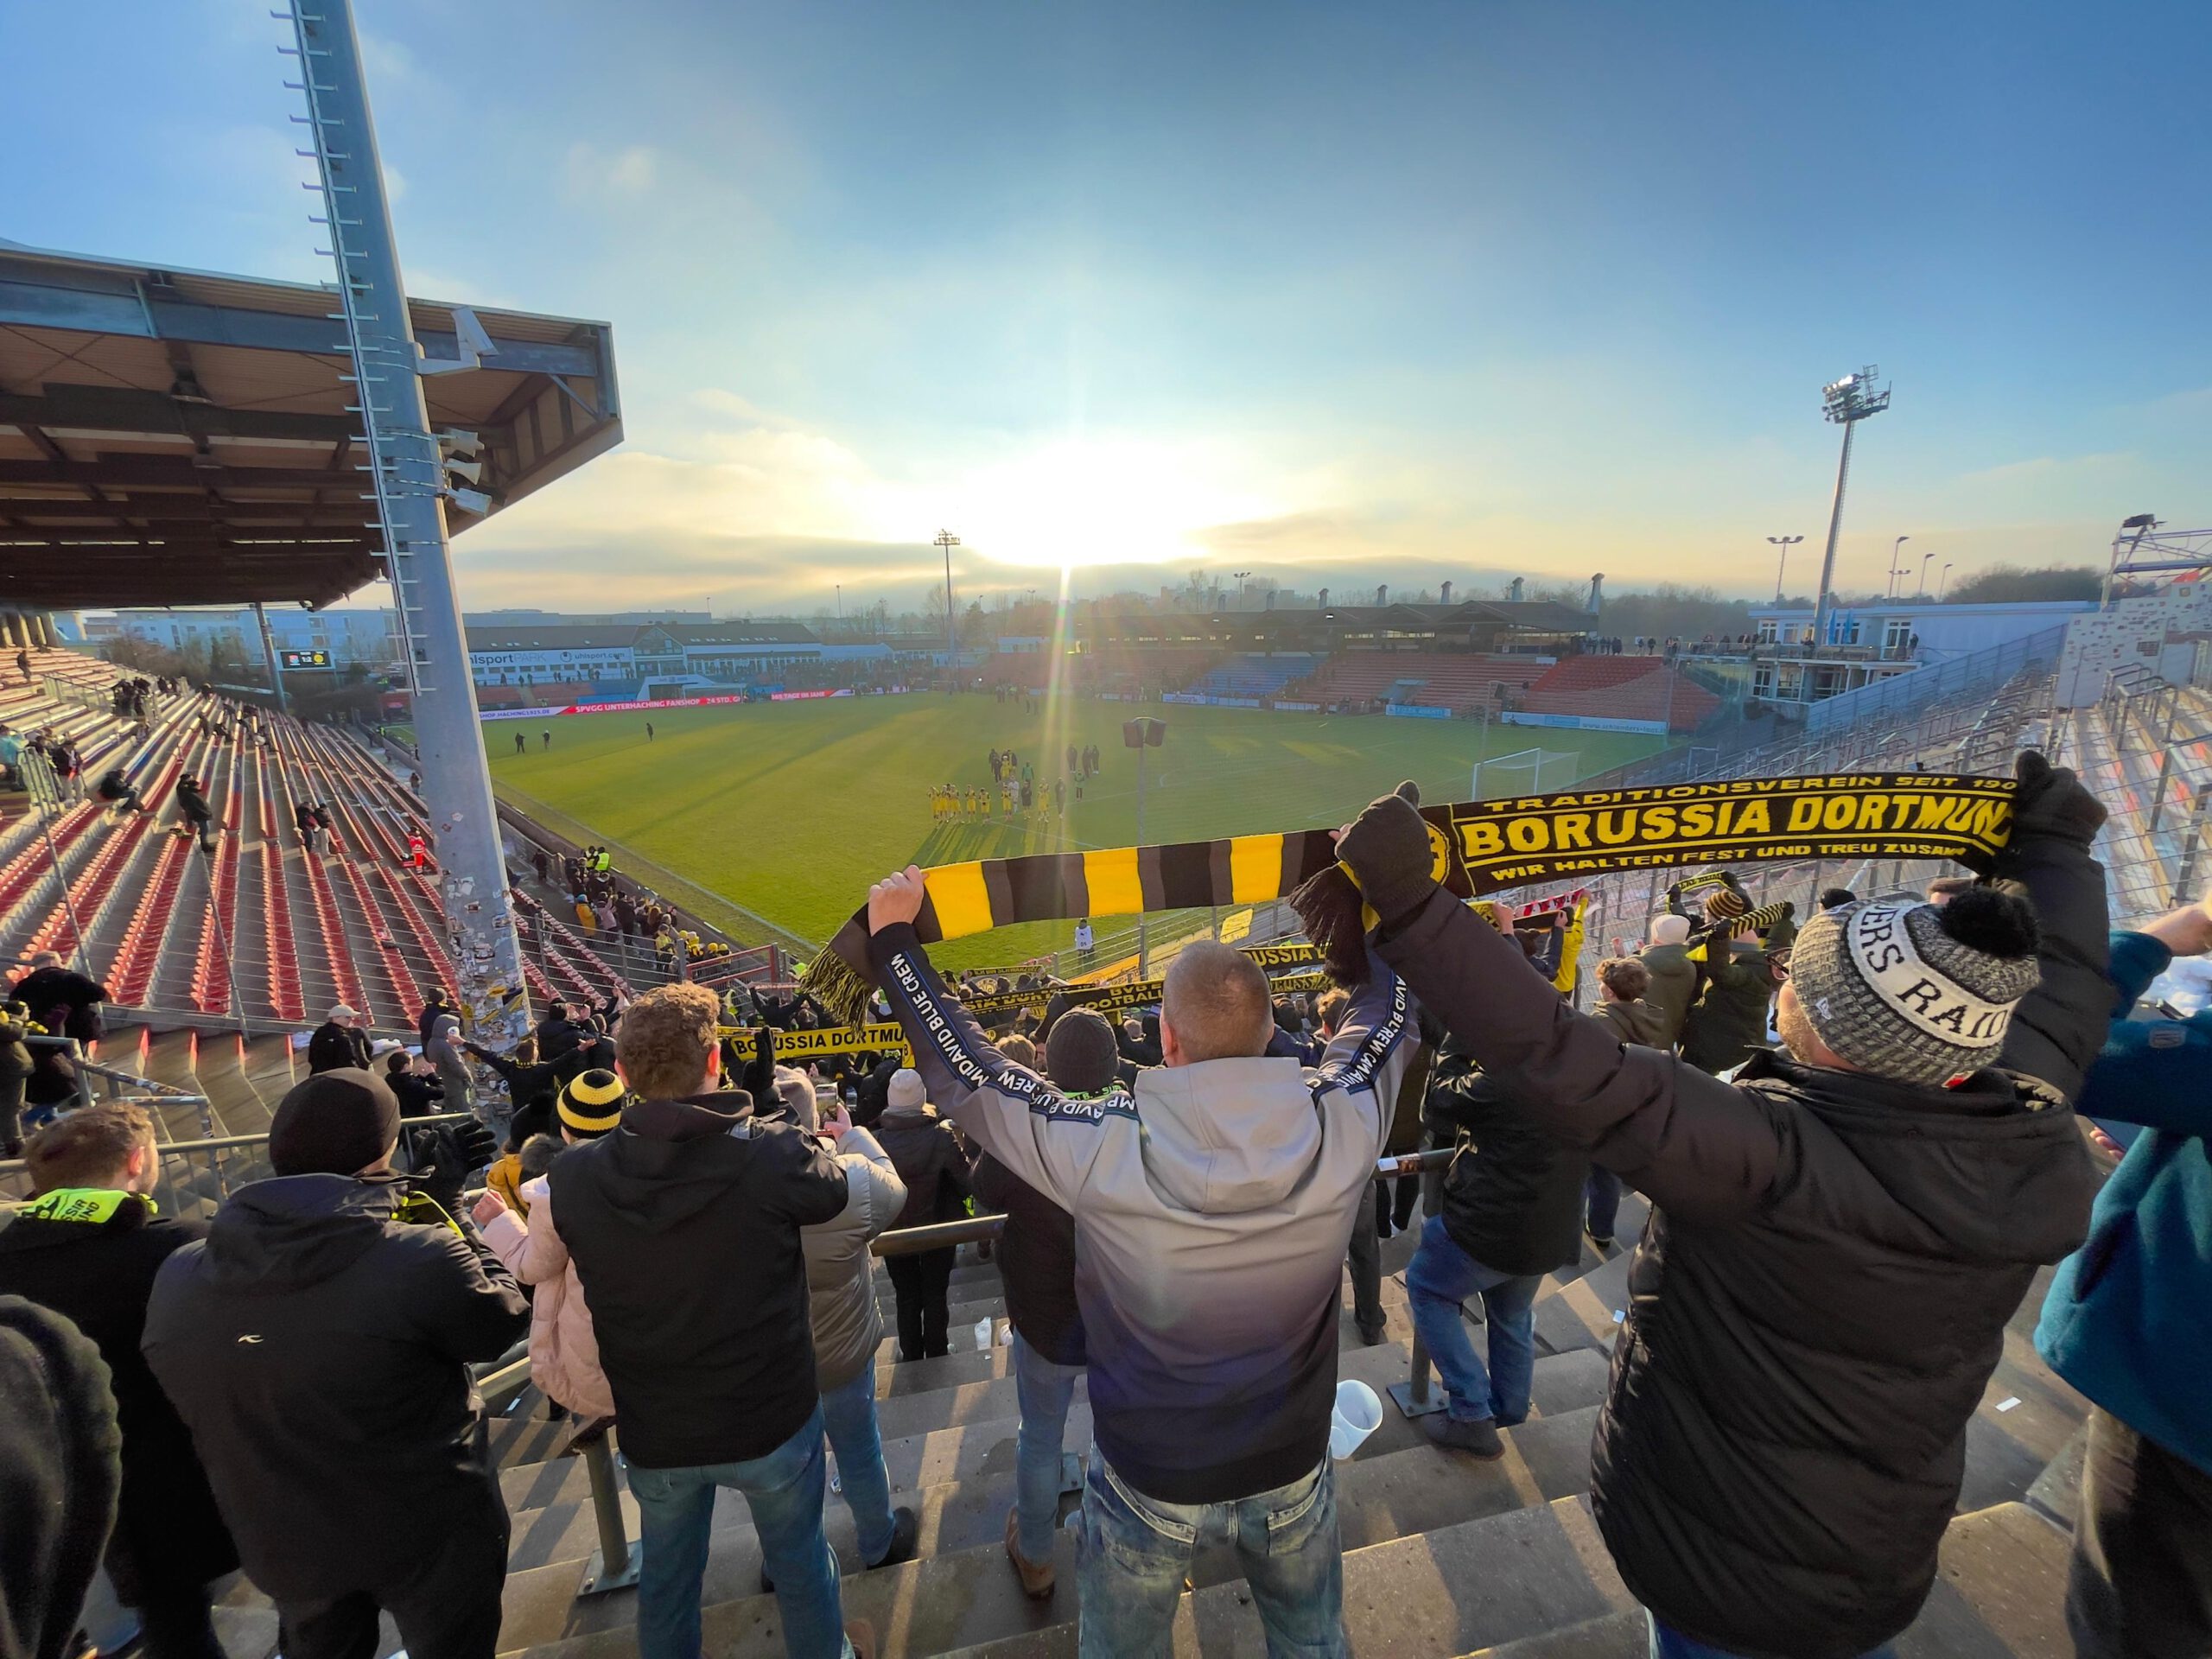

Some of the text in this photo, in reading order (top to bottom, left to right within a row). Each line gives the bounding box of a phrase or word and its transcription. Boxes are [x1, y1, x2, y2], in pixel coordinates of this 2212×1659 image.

[469, 652, 546, 666] lsportPARK
[575, 704, 603, 713] SPVGG
[604, 699, 664, 711] UNTERHACHING
[666, 697, 701, 708] FANSHOP
[1484, 776, 2018, 811] TRADITIONSVEREIN SEIT 190
[1461, 800, 1771, 857] BORUSSIA
[1491, 864, 1547, 881] WIR
[1554, 854, 1674, 872] HALTEN
[1681, 849, 1750, 862] FEST
[1757, 845, 1812, 858] UND
[1818, 843, 1878, 855] TREU
[1859, 905, 1904, 973] ERS
[1249, 948, 1313, 967] USSIA
[890, 952, 920, 993] CREW
[912, 990, 945, 1032] BLUE
[1077, 988, 1163, 1011] OOTBALL
[734, 1033, 827, 1054] BOUSSIA
[997, 1071, 1039, 1095] REW
